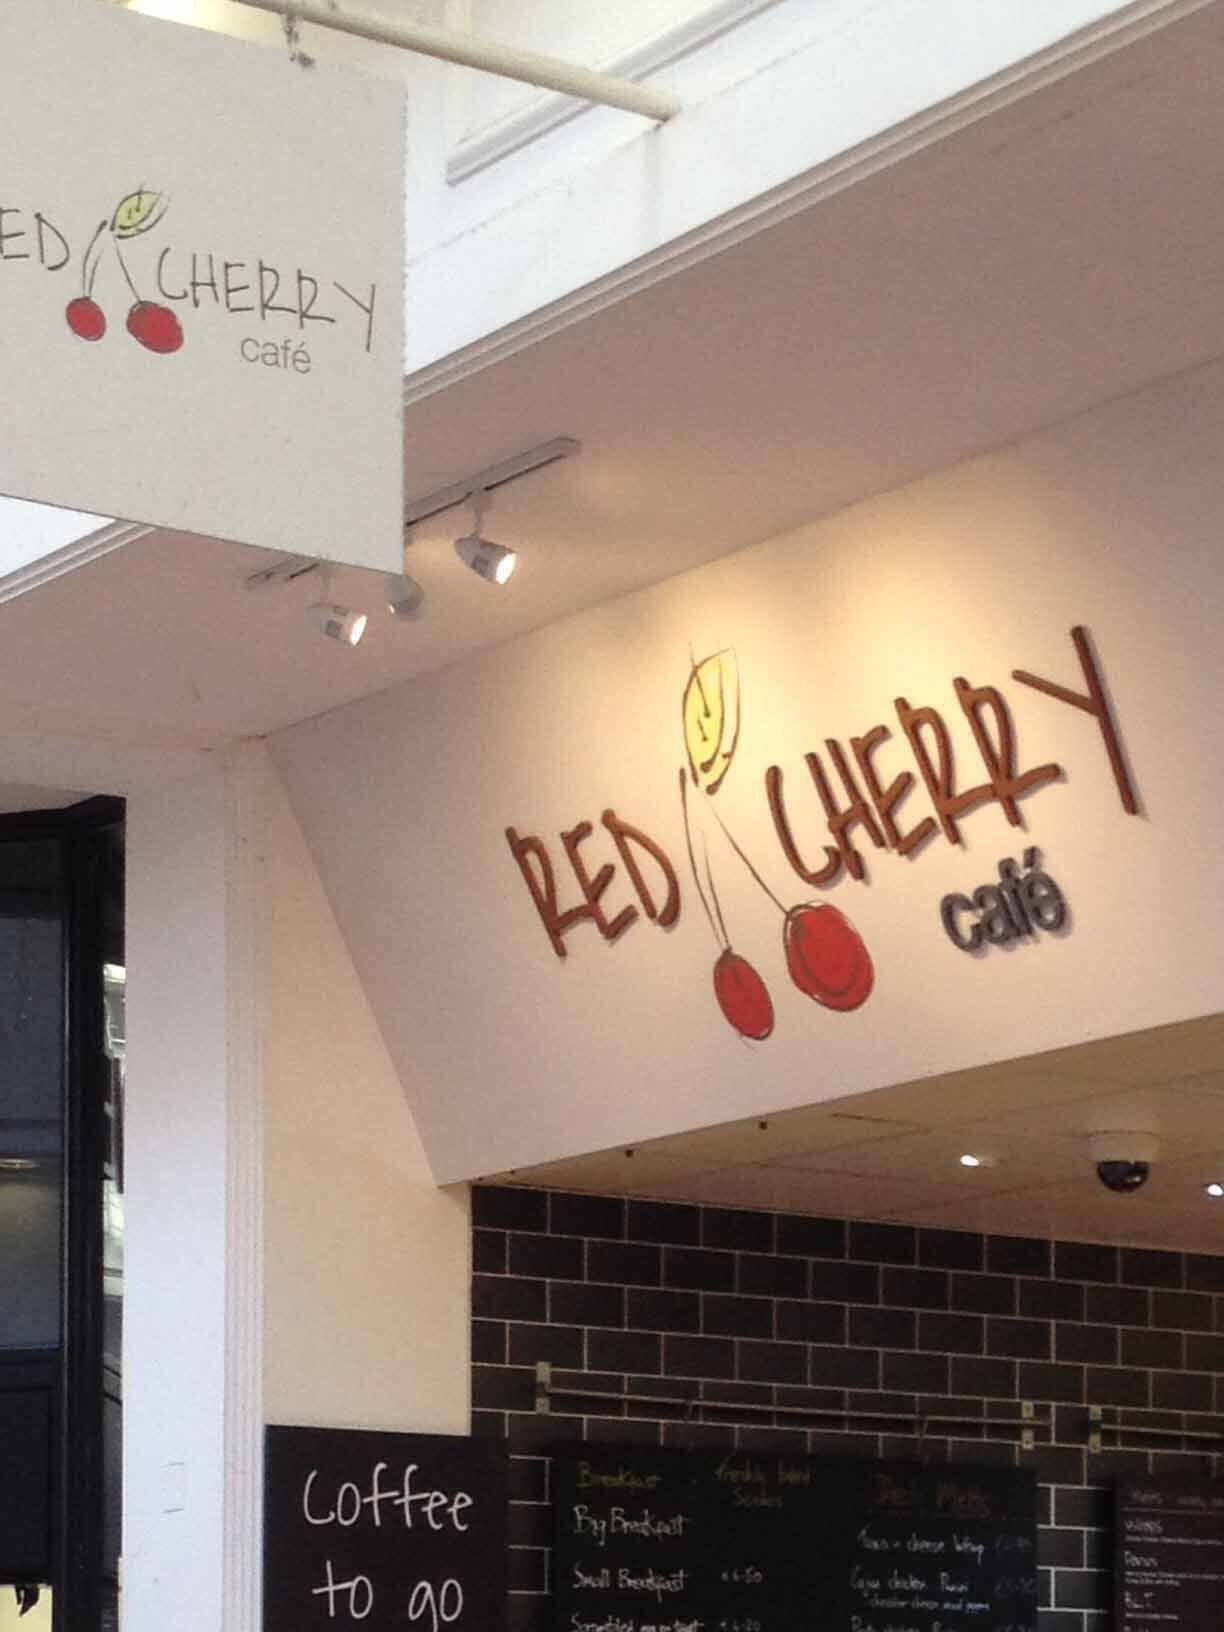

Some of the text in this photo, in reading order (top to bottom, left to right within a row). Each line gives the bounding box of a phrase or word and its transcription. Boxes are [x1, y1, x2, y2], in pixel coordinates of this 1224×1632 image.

[157, 246, 377, 354] CHERRY
[240, 336, 313, 375] café
[505, 625, 1142, 957] RED CHERRY
[939, 847, 1072, 956] café
[303, 1462, 475, 1533] Coffee
[311, 1559, 374, 1620] to
